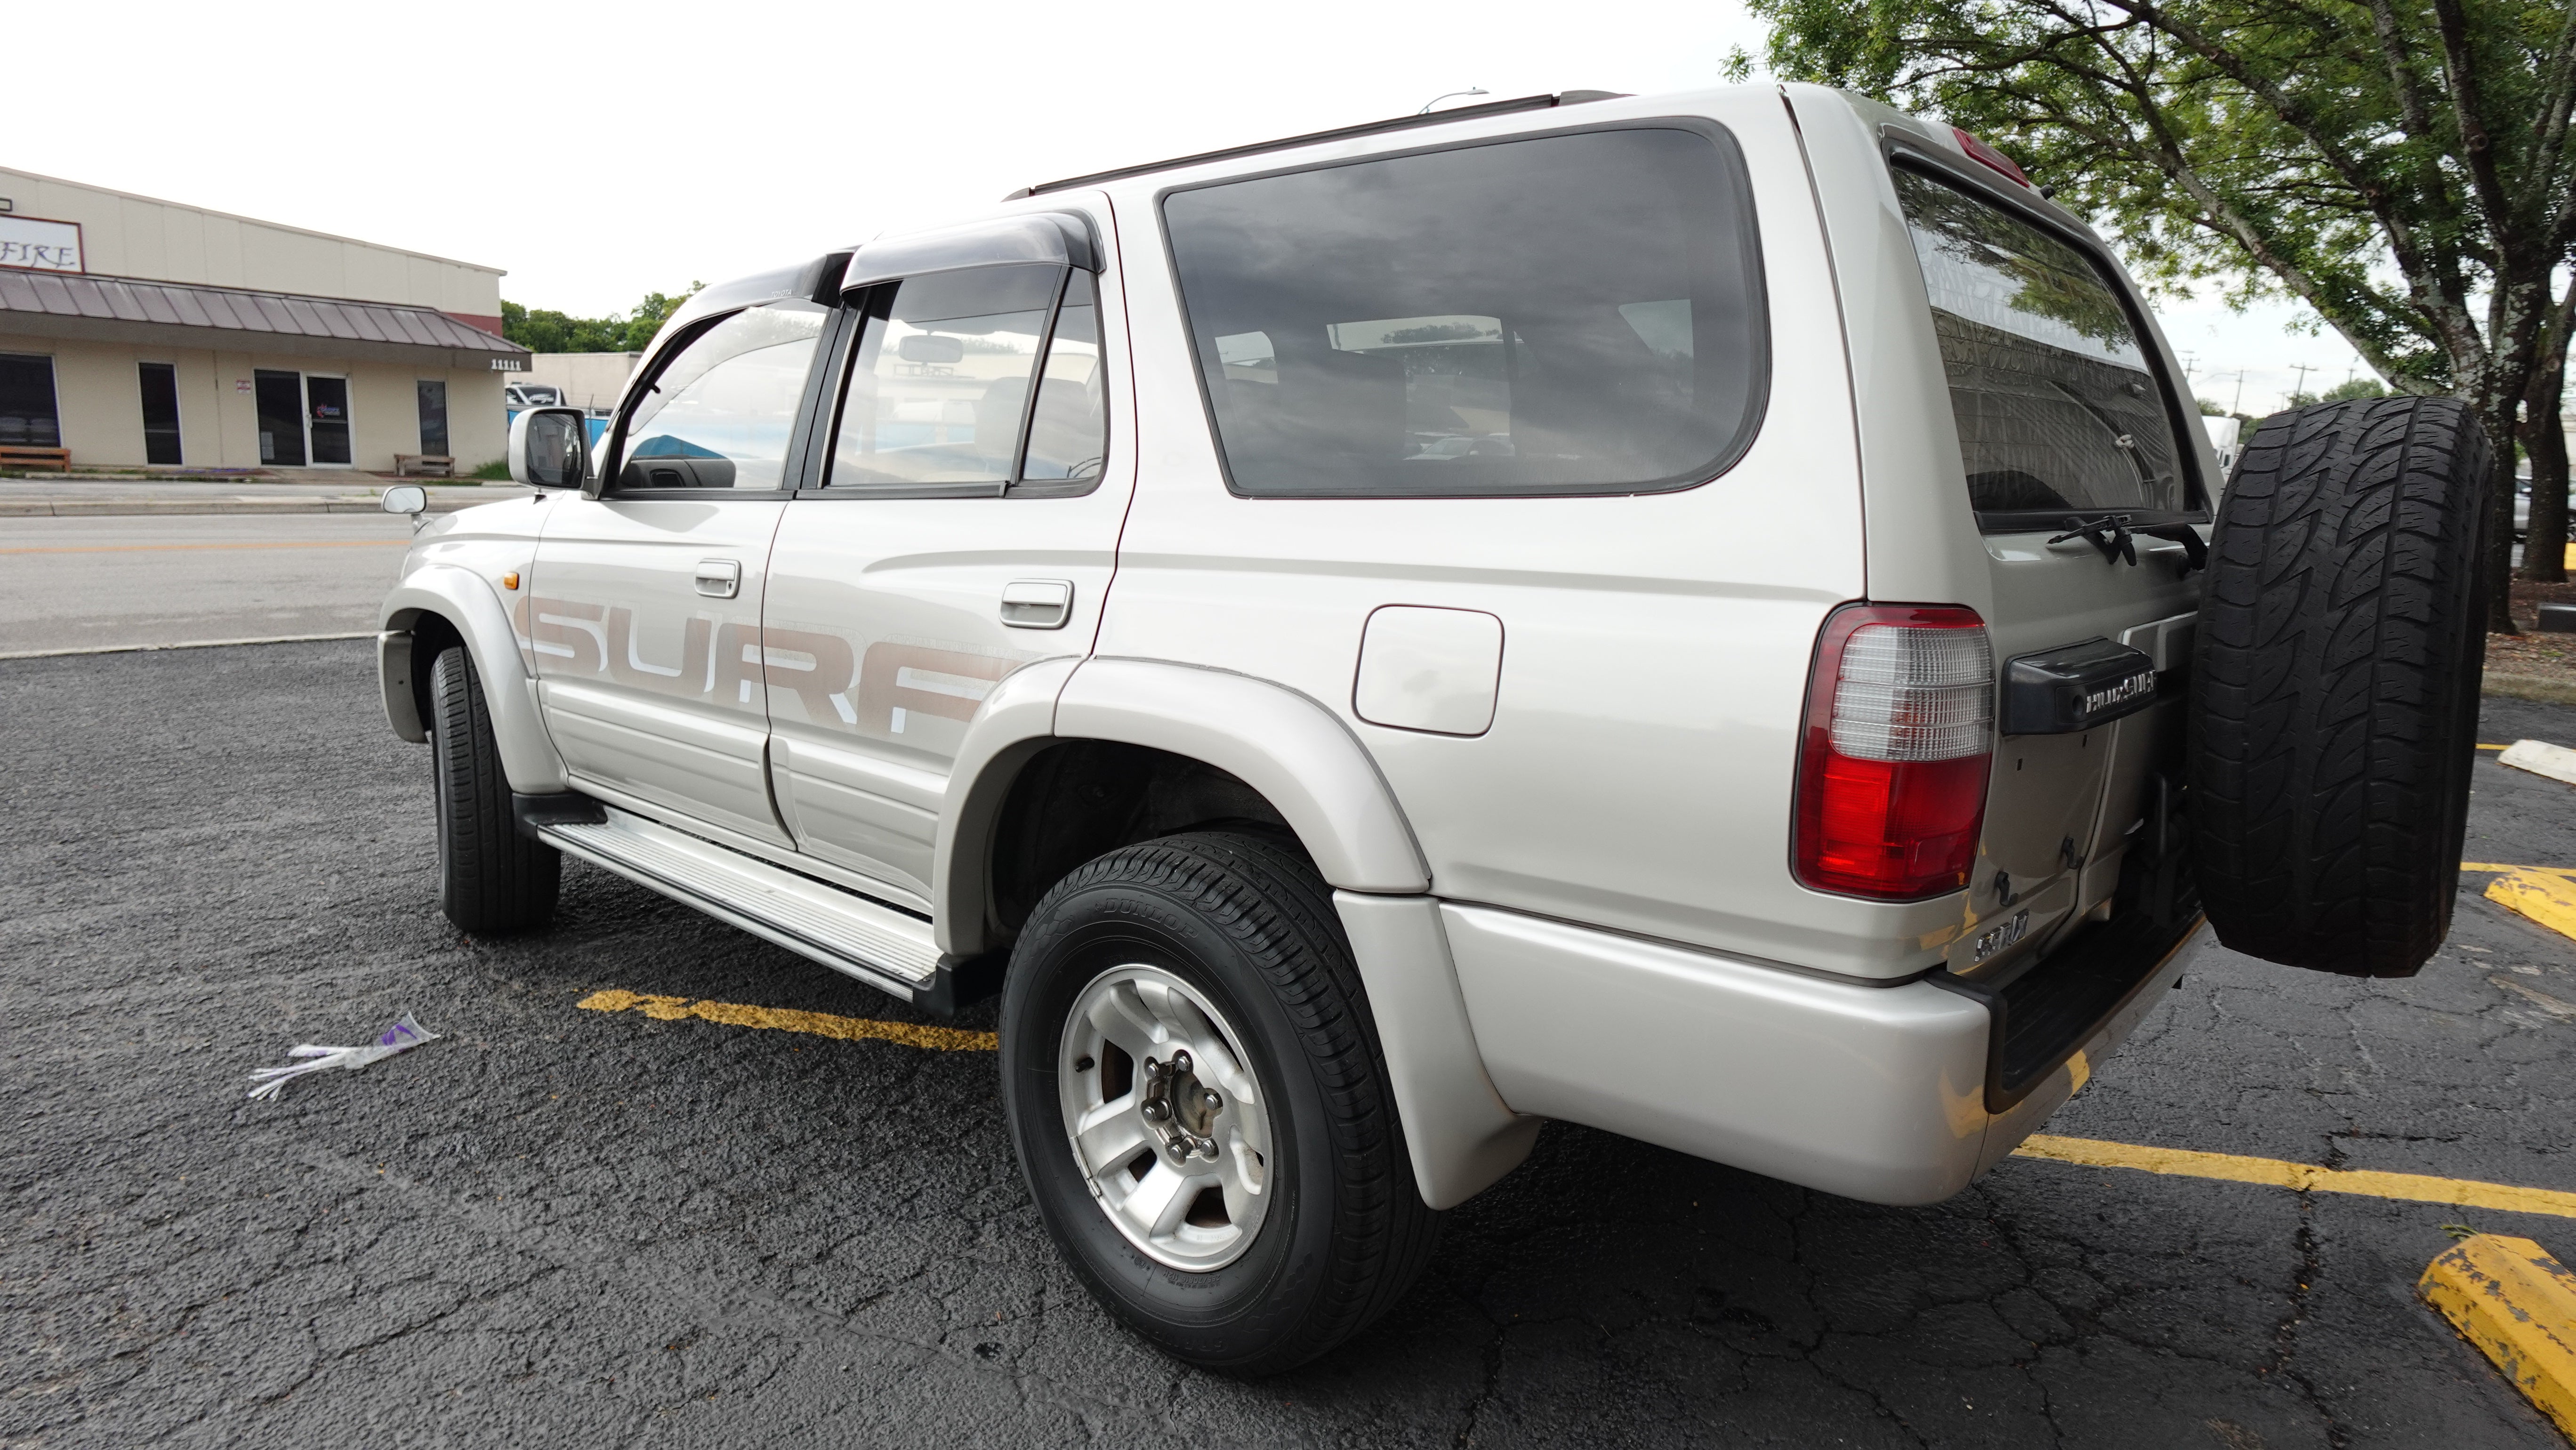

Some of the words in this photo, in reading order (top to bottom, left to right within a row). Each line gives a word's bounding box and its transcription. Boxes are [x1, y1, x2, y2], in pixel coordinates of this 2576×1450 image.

[772, 289, 792, 297] TOYOTA
[491, 358, 522, 371] 11111
[514, 592, 1029, 740] SURF
[1103, 897, 1199, 939] DUNLOP
